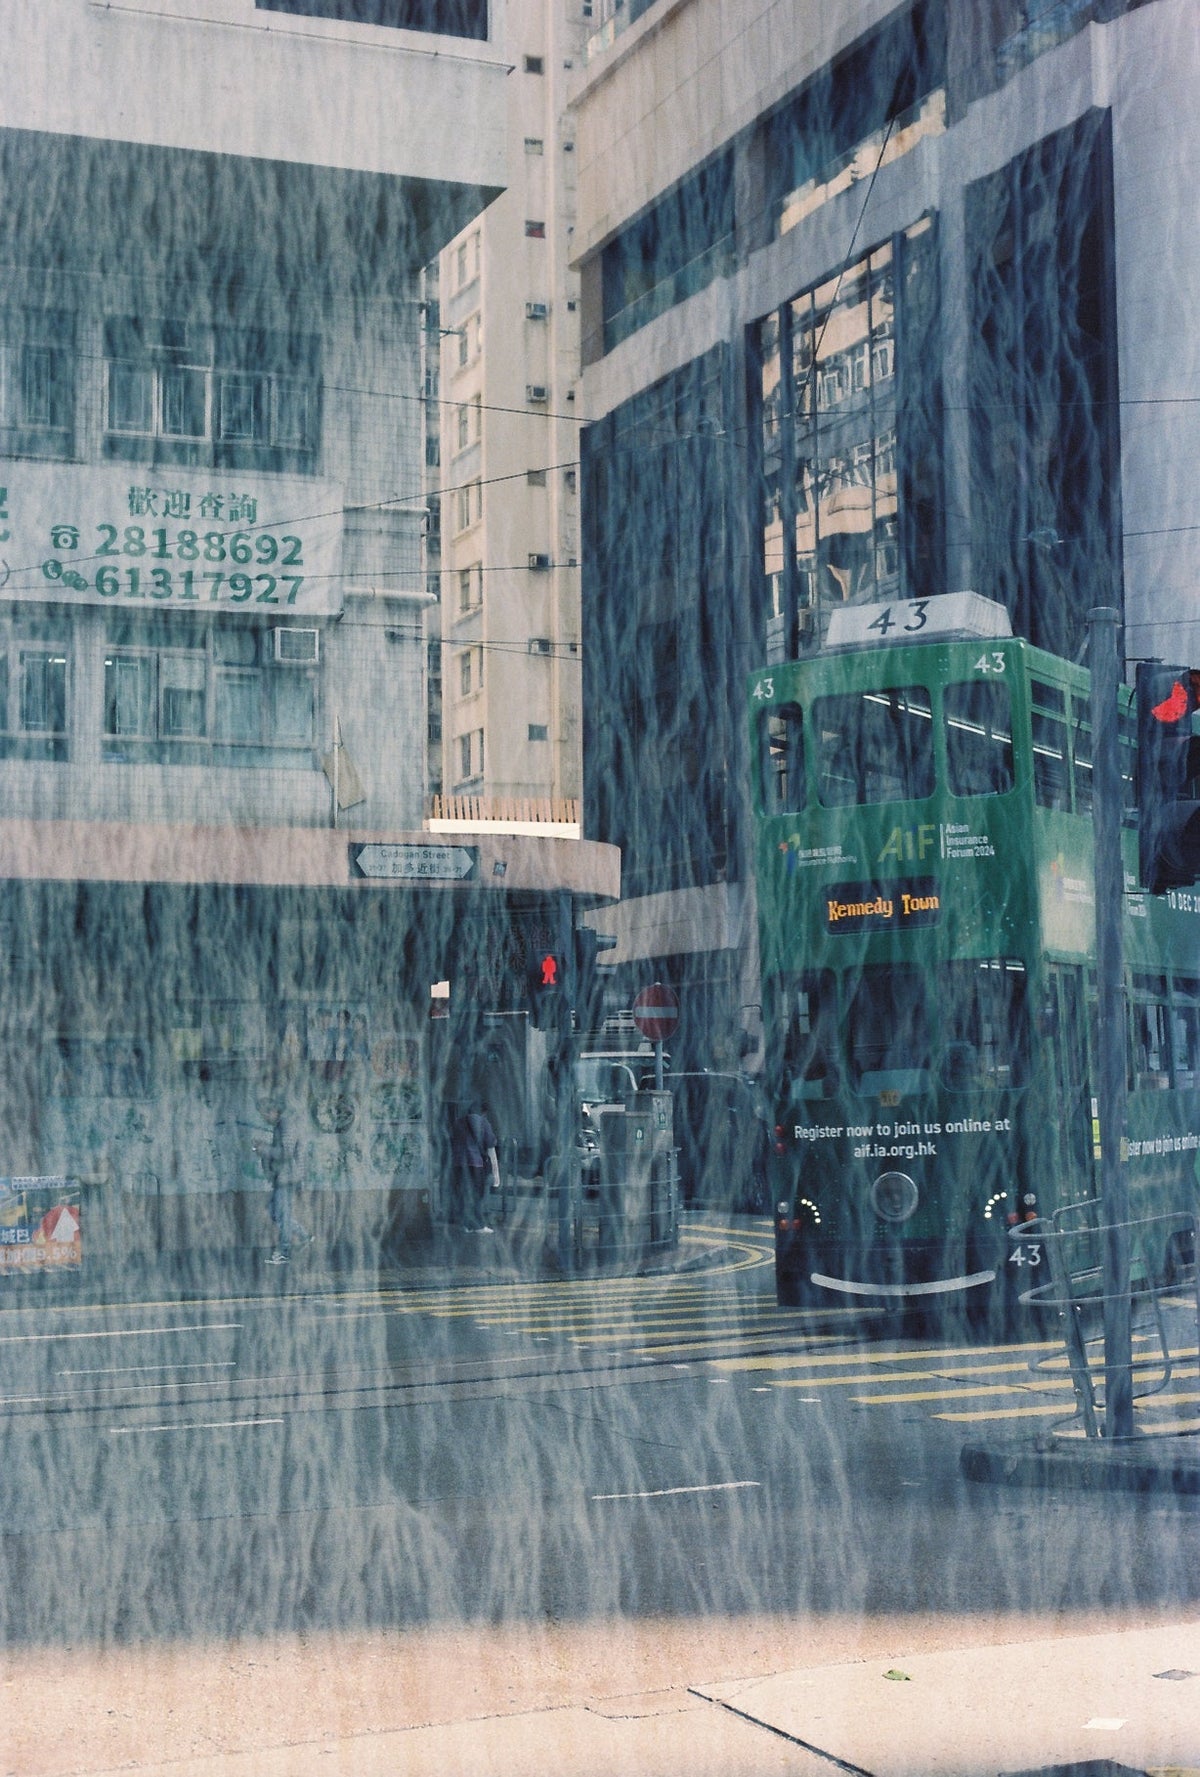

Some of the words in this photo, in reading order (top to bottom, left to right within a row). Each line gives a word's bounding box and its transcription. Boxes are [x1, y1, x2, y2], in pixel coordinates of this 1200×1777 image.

[128, 486, 257, 524] 歡迎查詢
[95, 524, 304, 566] 28188692
[95, 565, 304, 605] 61317927
[867, 600, 930, 635] 43
[974, 652, 1006, 674] 43
[752, 678, 775, 700] 43
[945, 823, 969, 834] Asian
[945, 835, 988, 846] Insurance
[946, 847, 974, 858] Forum
[974, 844, 995, 857] 2024
[380, 849, 420, 859] Cadogan
[422, 850, 450, 860] Street
[391, 862, 440, 875] 加多近街
[828, 896, 893, 921] Kennedy
[901, 894, 939, 914] Town
[1178, 892, 1192, 912] DEC
[794, 1124, 844, 1141] Register
[846, 1125, 873, 1137] now
[876, 1123, 891, 1136] to
[894, 1121, 920, 1138] join
[924, 1122, 942, 1134] us
[945, 1118, 991, 1133] online
[994, 1118, 1011, 1131] at
[854, 1141, 937, 1160] aif.ia.org.hk
[1008, 1244, 1041, 1267] 43
